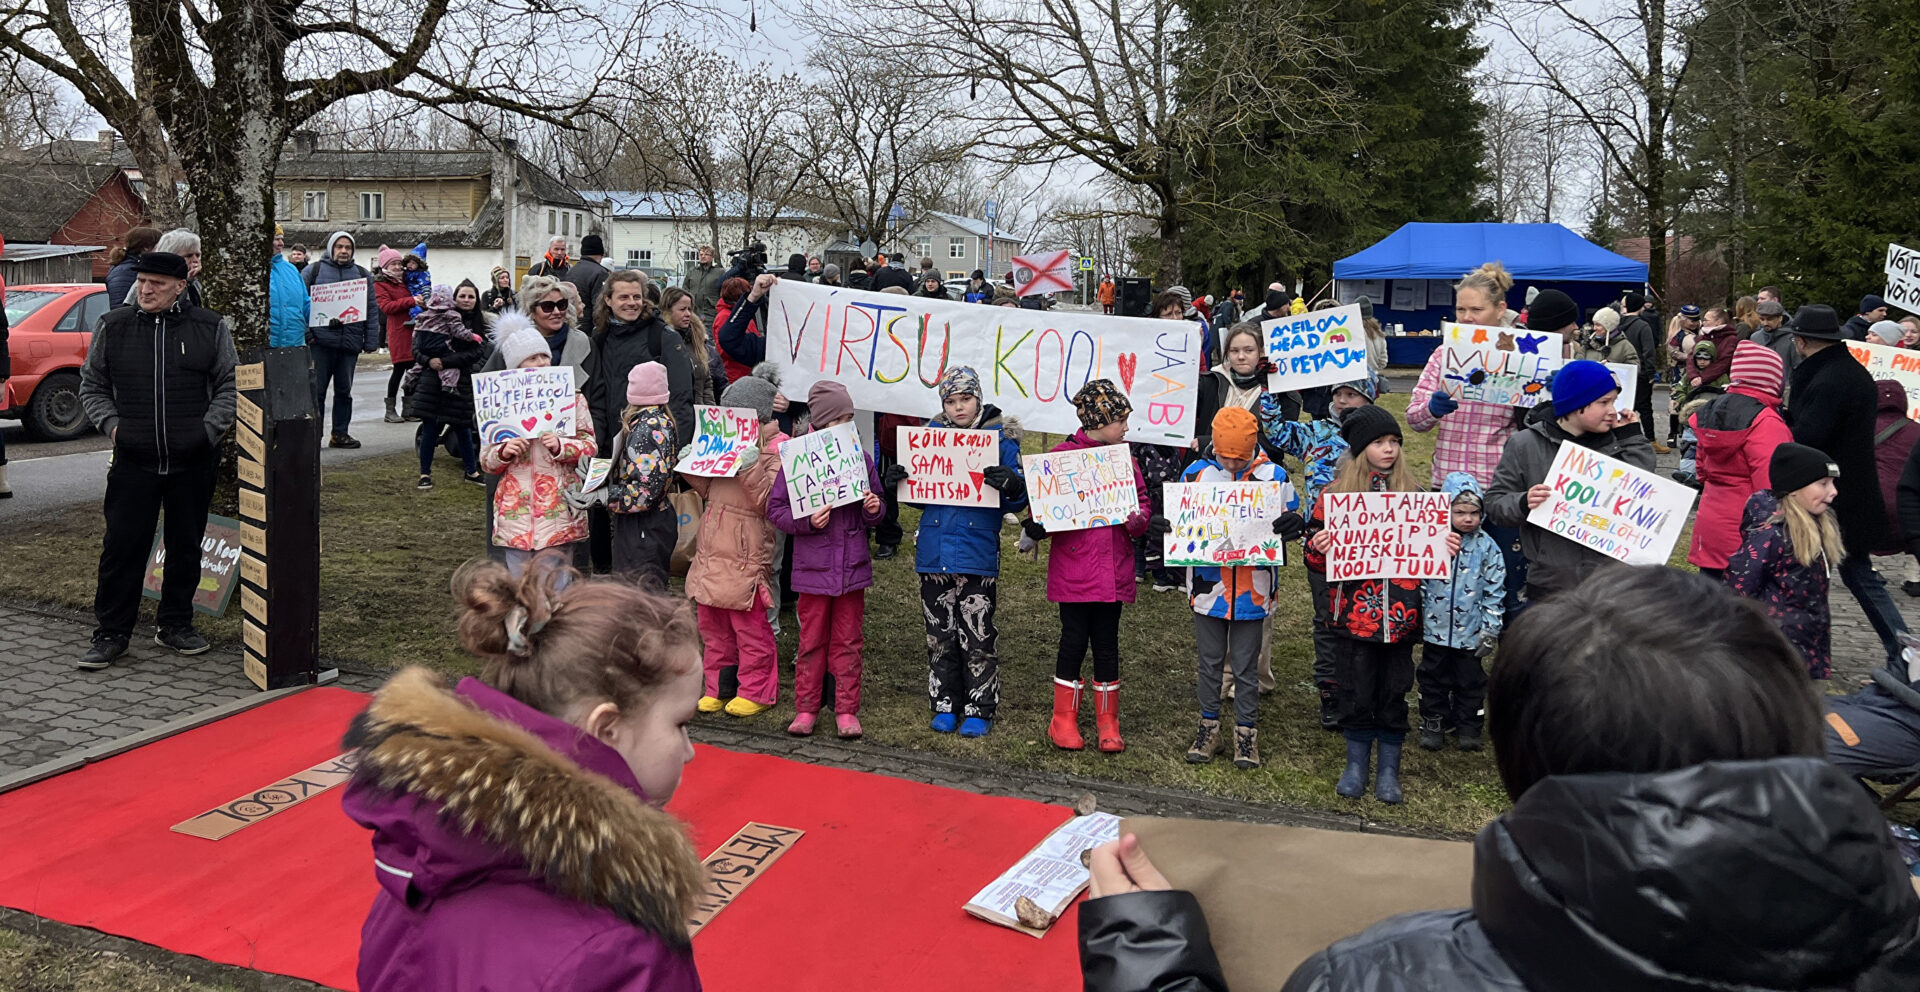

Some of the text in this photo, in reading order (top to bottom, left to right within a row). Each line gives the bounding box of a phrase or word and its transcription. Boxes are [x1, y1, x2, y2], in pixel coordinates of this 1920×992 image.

[911, 453, 954, 476] SAMA
[787, 465, 836, 498] TAHA
[1330, 492, 1451, 513] MA TAHAN
[1329, 514, 1350, 530] KA
[1357, 508, 1396, 526] OMA
[1393, 558, 1448, 577] TUUA
